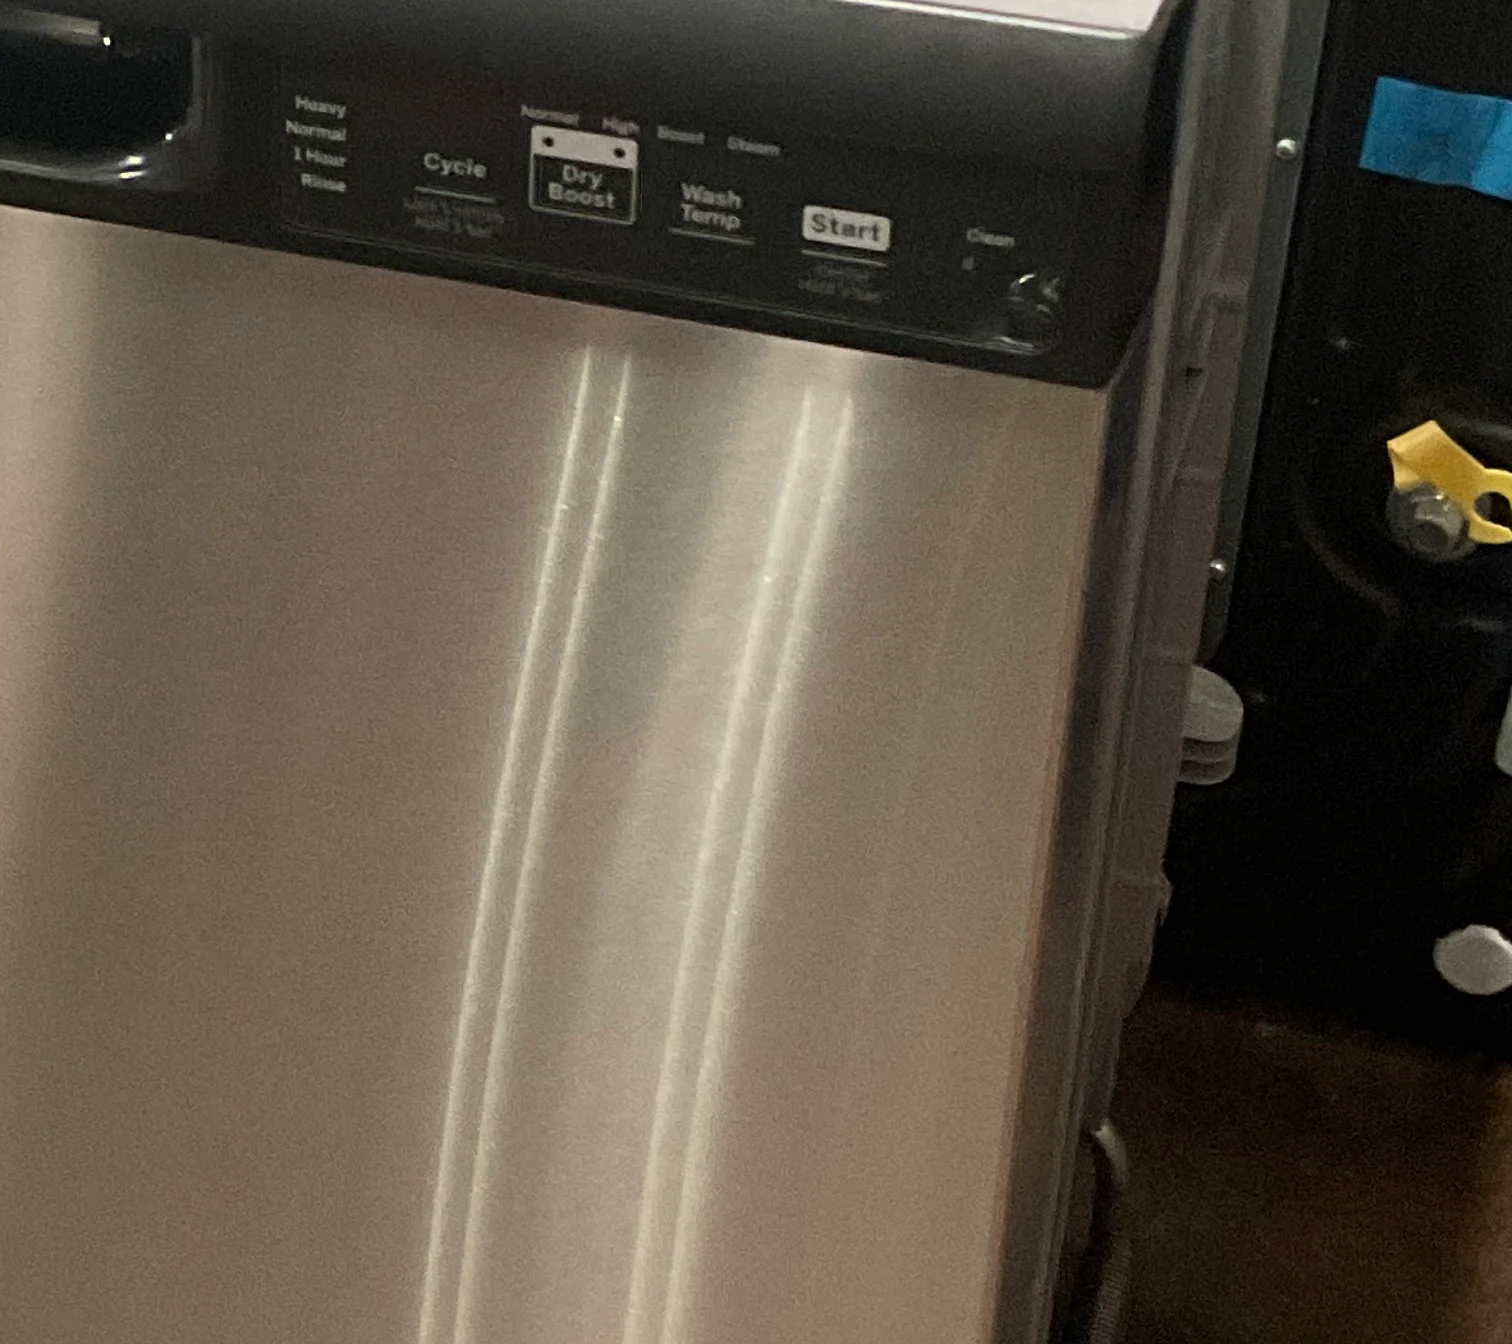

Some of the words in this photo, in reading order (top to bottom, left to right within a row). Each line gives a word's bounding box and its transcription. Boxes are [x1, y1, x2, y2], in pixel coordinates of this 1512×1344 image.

[295, 95, 346, 119] Heavy
[286, 120, 346, 141] Normal
[306, 147, 346, 167] Hour
[423, 152, 488, 178] Cycle
[562, 164, 603, 189] Dry
[548, 182, 615, 210] Boost
[681, 183, 743, 209] Wash
[681, 203, 741, 232] Temp
[811, 213, 881, 242] Start
